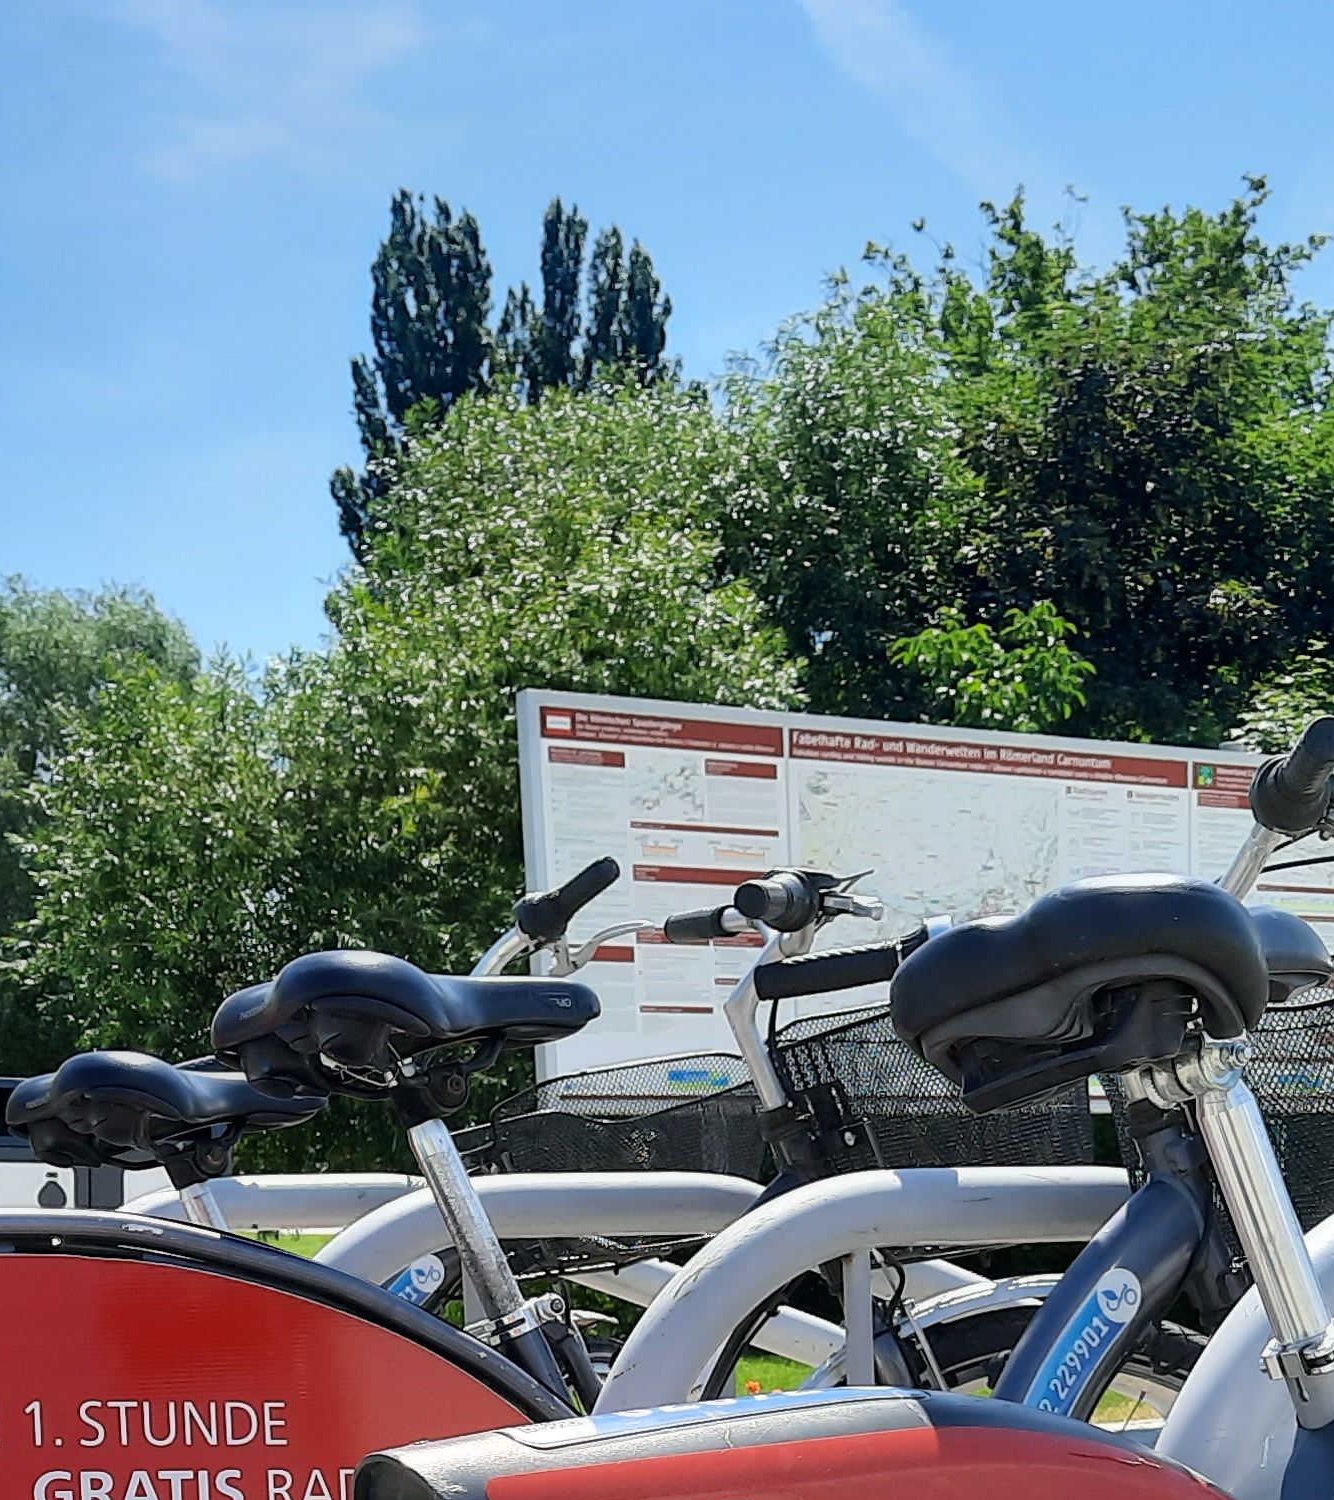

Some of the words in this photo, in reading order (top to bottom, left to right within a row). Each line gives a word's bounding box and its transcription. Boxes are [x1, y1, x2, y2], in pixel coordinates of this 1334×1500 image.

[1050, 1315, 1110, 1401] 229901
[23, 1400, 63, 1447] 1.
[79, 1399, 289, 1448] STUNDE
